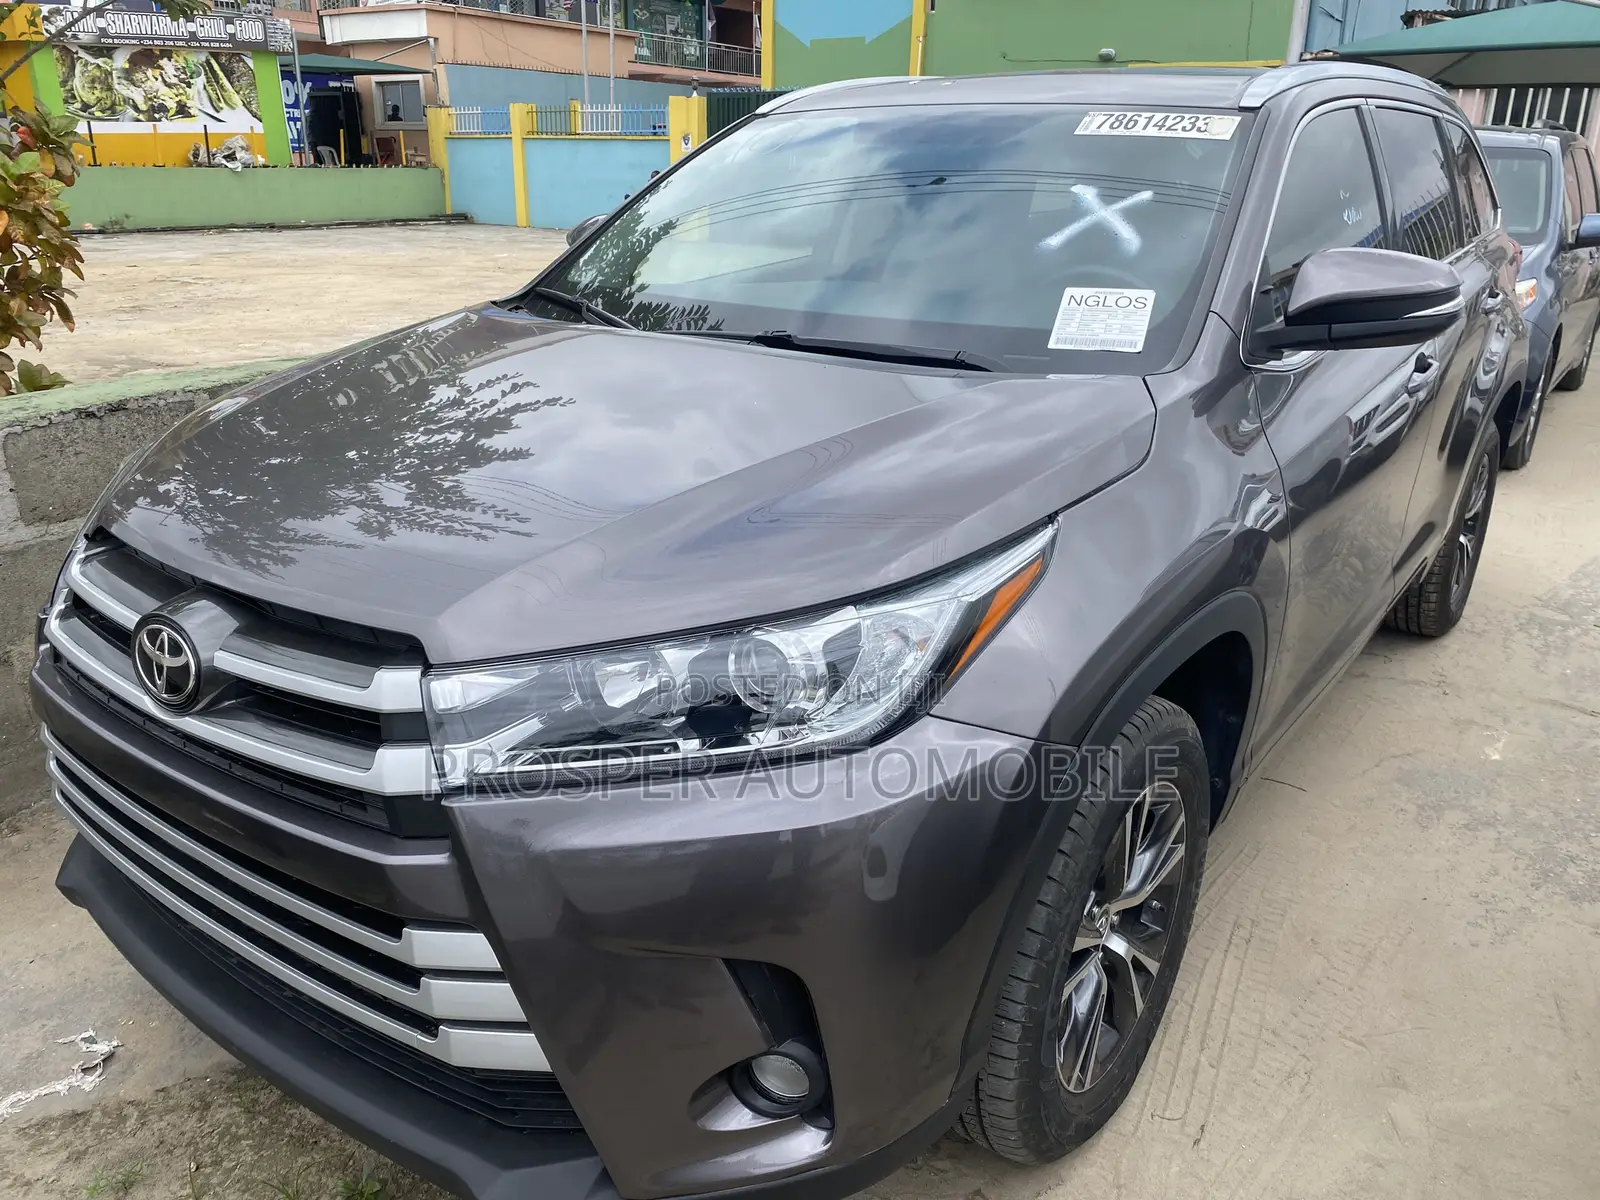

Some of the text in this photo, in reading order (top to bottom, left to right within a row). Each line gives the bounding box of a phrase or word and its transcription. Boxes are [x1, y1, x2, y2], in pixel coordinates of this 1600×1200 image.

[195, 18, 227, 38] GRILL
[235, 19, 263, 40] FOOD
[1067, 294, 1148, 310] NGLOS
